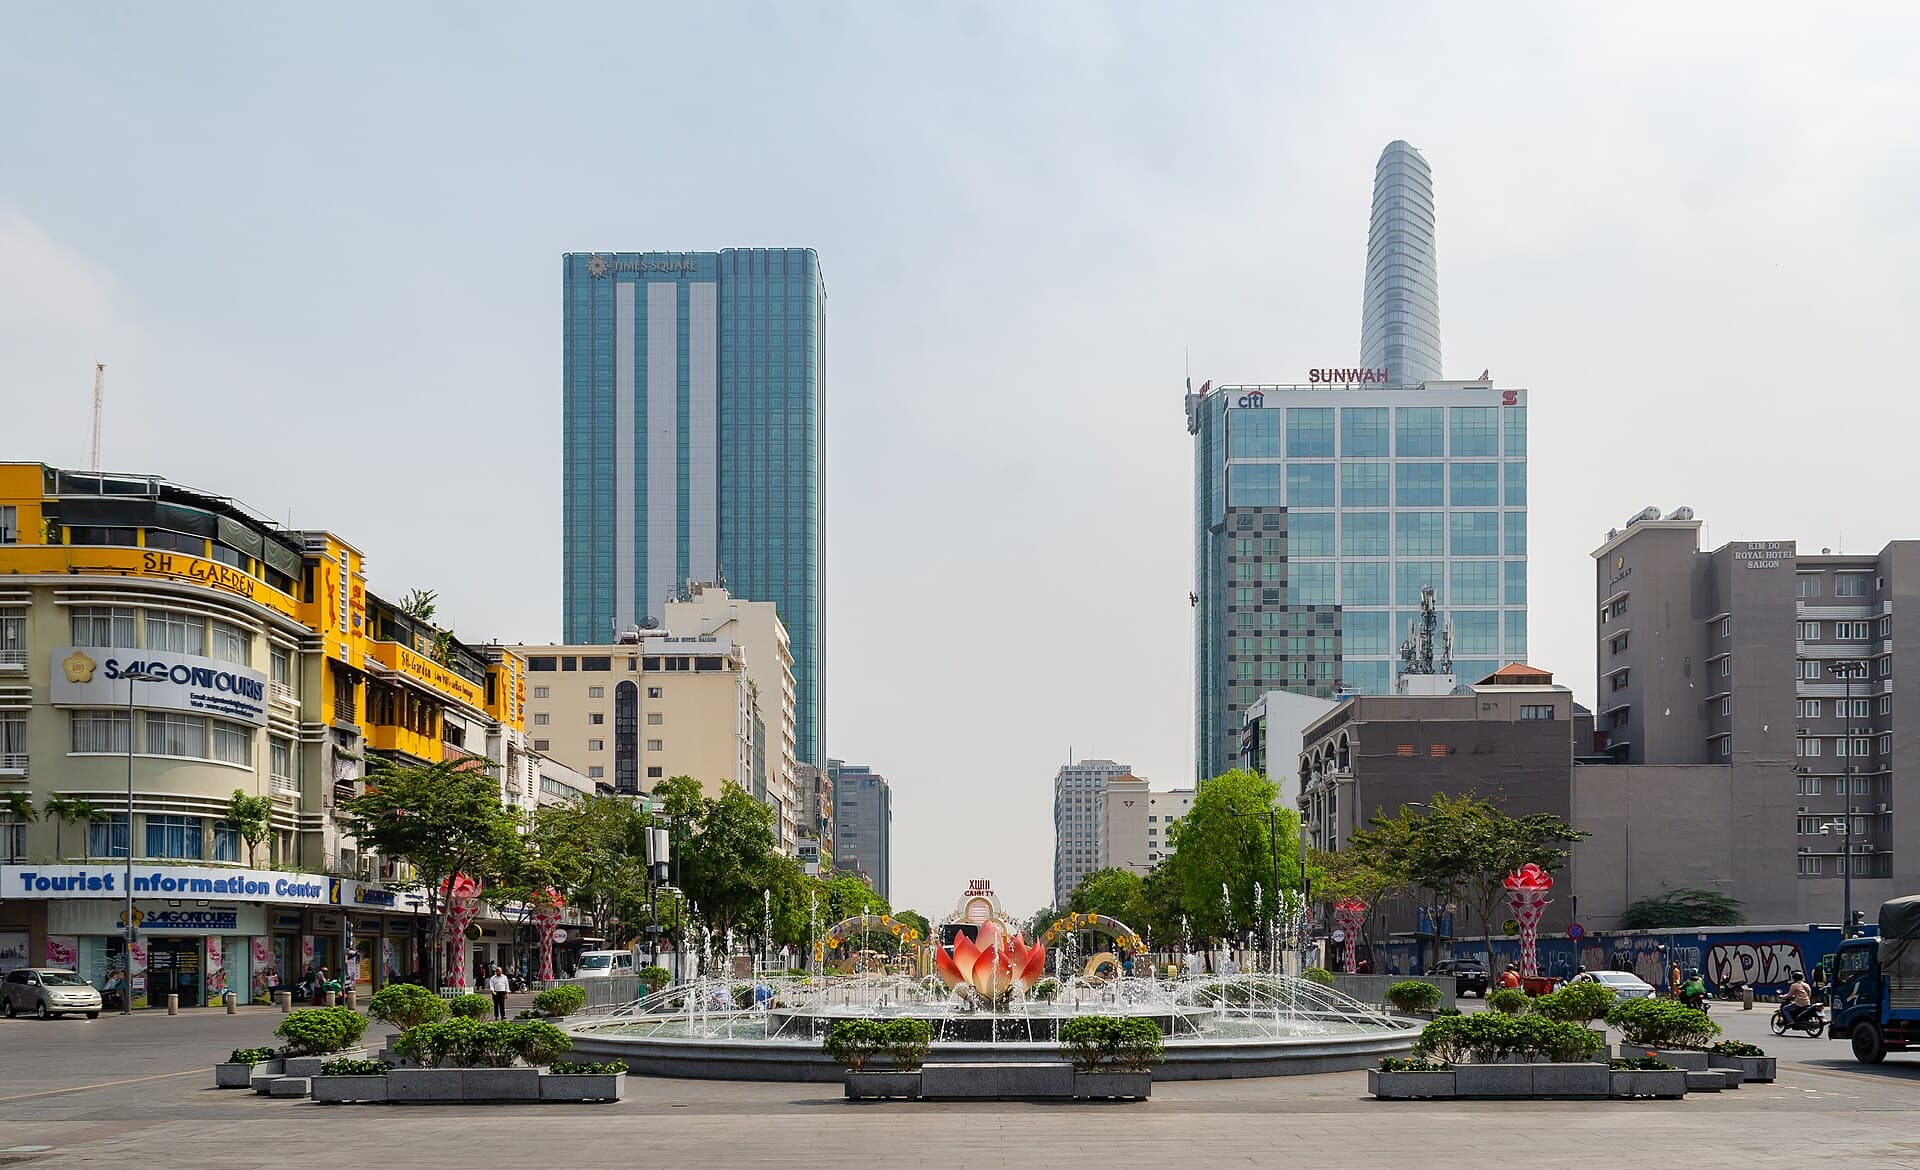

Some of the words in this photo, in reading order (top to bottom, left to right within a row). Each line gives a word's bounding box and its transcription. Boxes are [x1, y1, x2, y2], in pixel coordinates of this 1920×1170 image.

[614, 261, 647, 271] TIMES
[651, 261, 697, 273] SQUARE
[1309, 368, 1389, 383] SUNWAH
[1239, 391, 1264, 408] citi
[1735, 551, 1764, 559] ROYAL
[1766, 551, 1794, 559] HOTEL
[1747, 560, 1780, 569] SAIGON
[190, 560, 255, 593] GARDEN
[104, 658, 265, 701] SAIGONTOURIST
[20, 872, 114, 891] Tourist
[276, 879, 321, 898] Center
